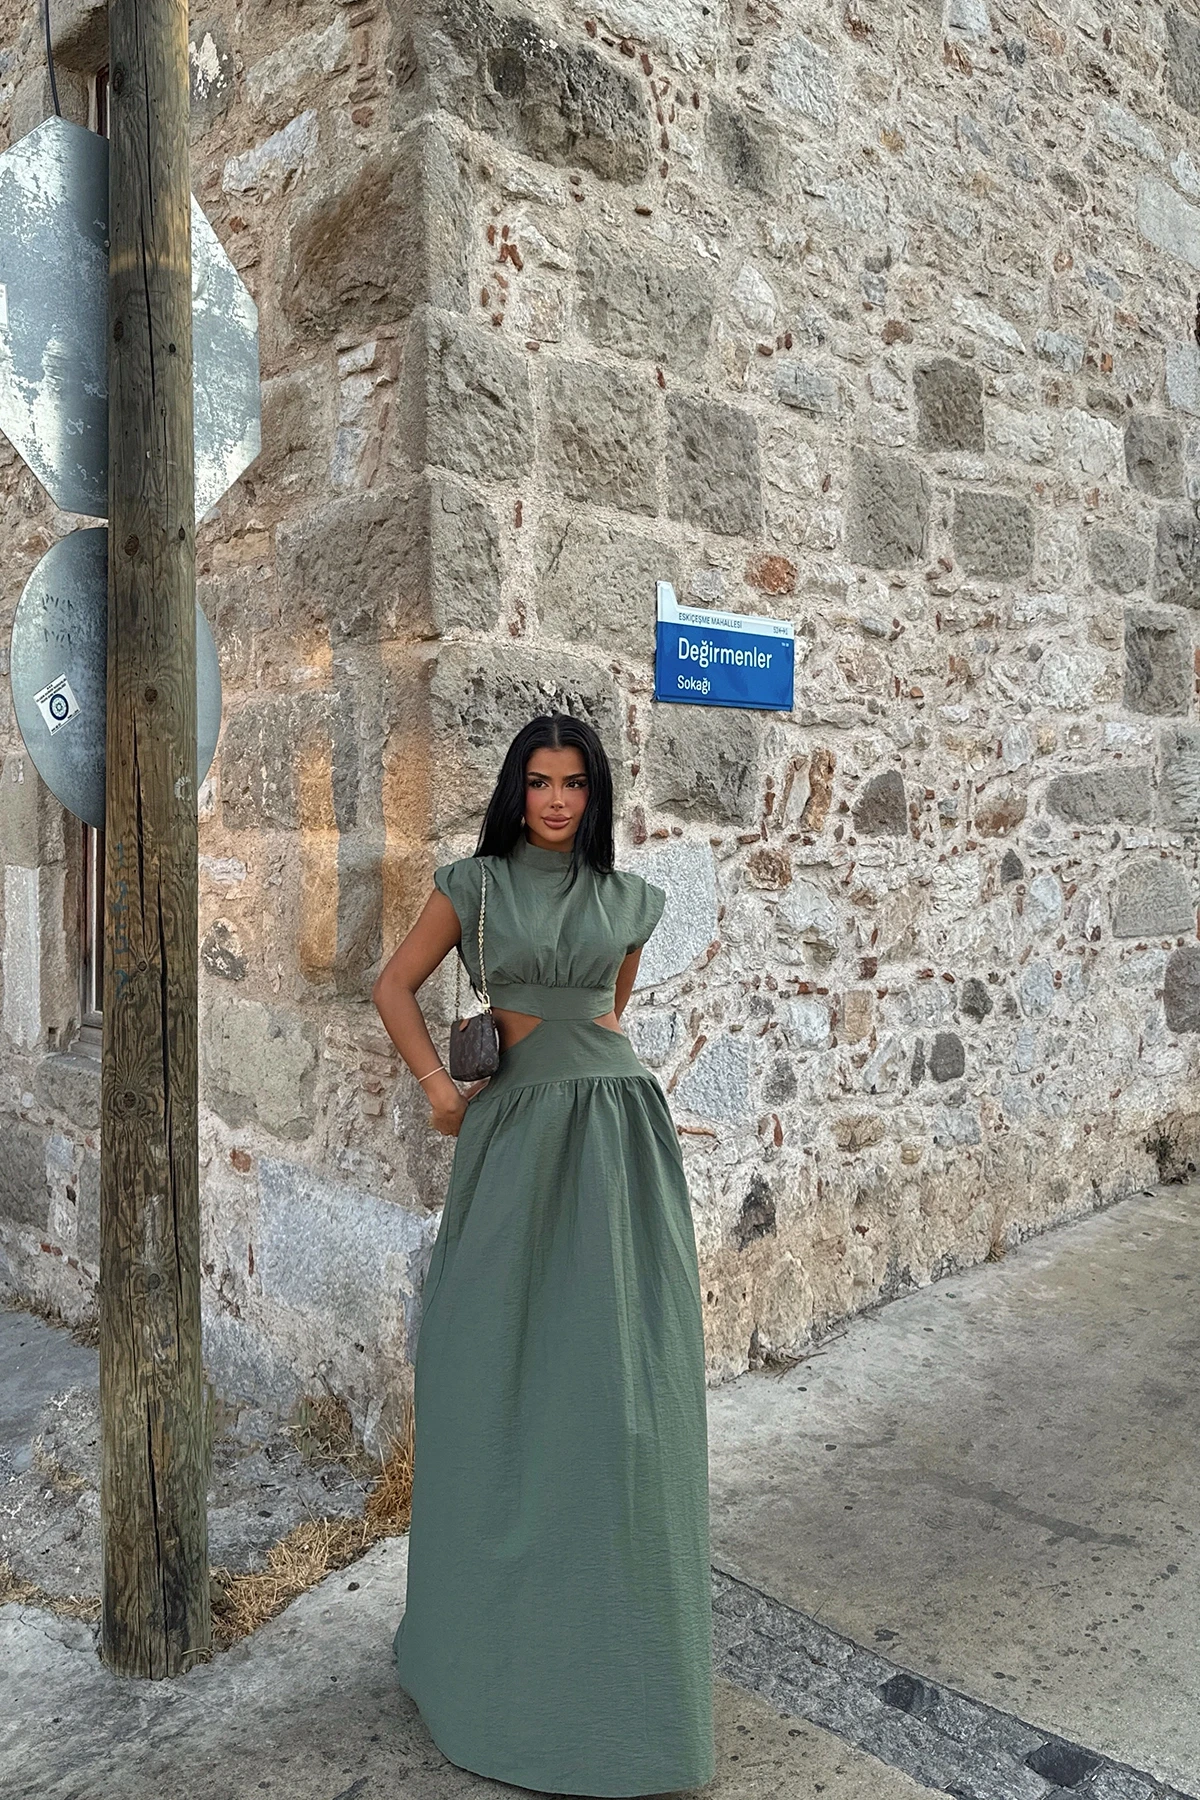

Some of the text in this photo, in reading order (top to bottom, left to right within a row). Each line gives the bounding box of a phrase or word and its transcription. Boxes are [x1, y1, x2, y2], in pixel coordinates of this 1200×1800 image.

[678, 612, 742, 629] ESKİÇEŞME MAHALLESİ
[678, 637, 772, 669] Değirmenler
[677, 674, 711, 695] Sokağı
